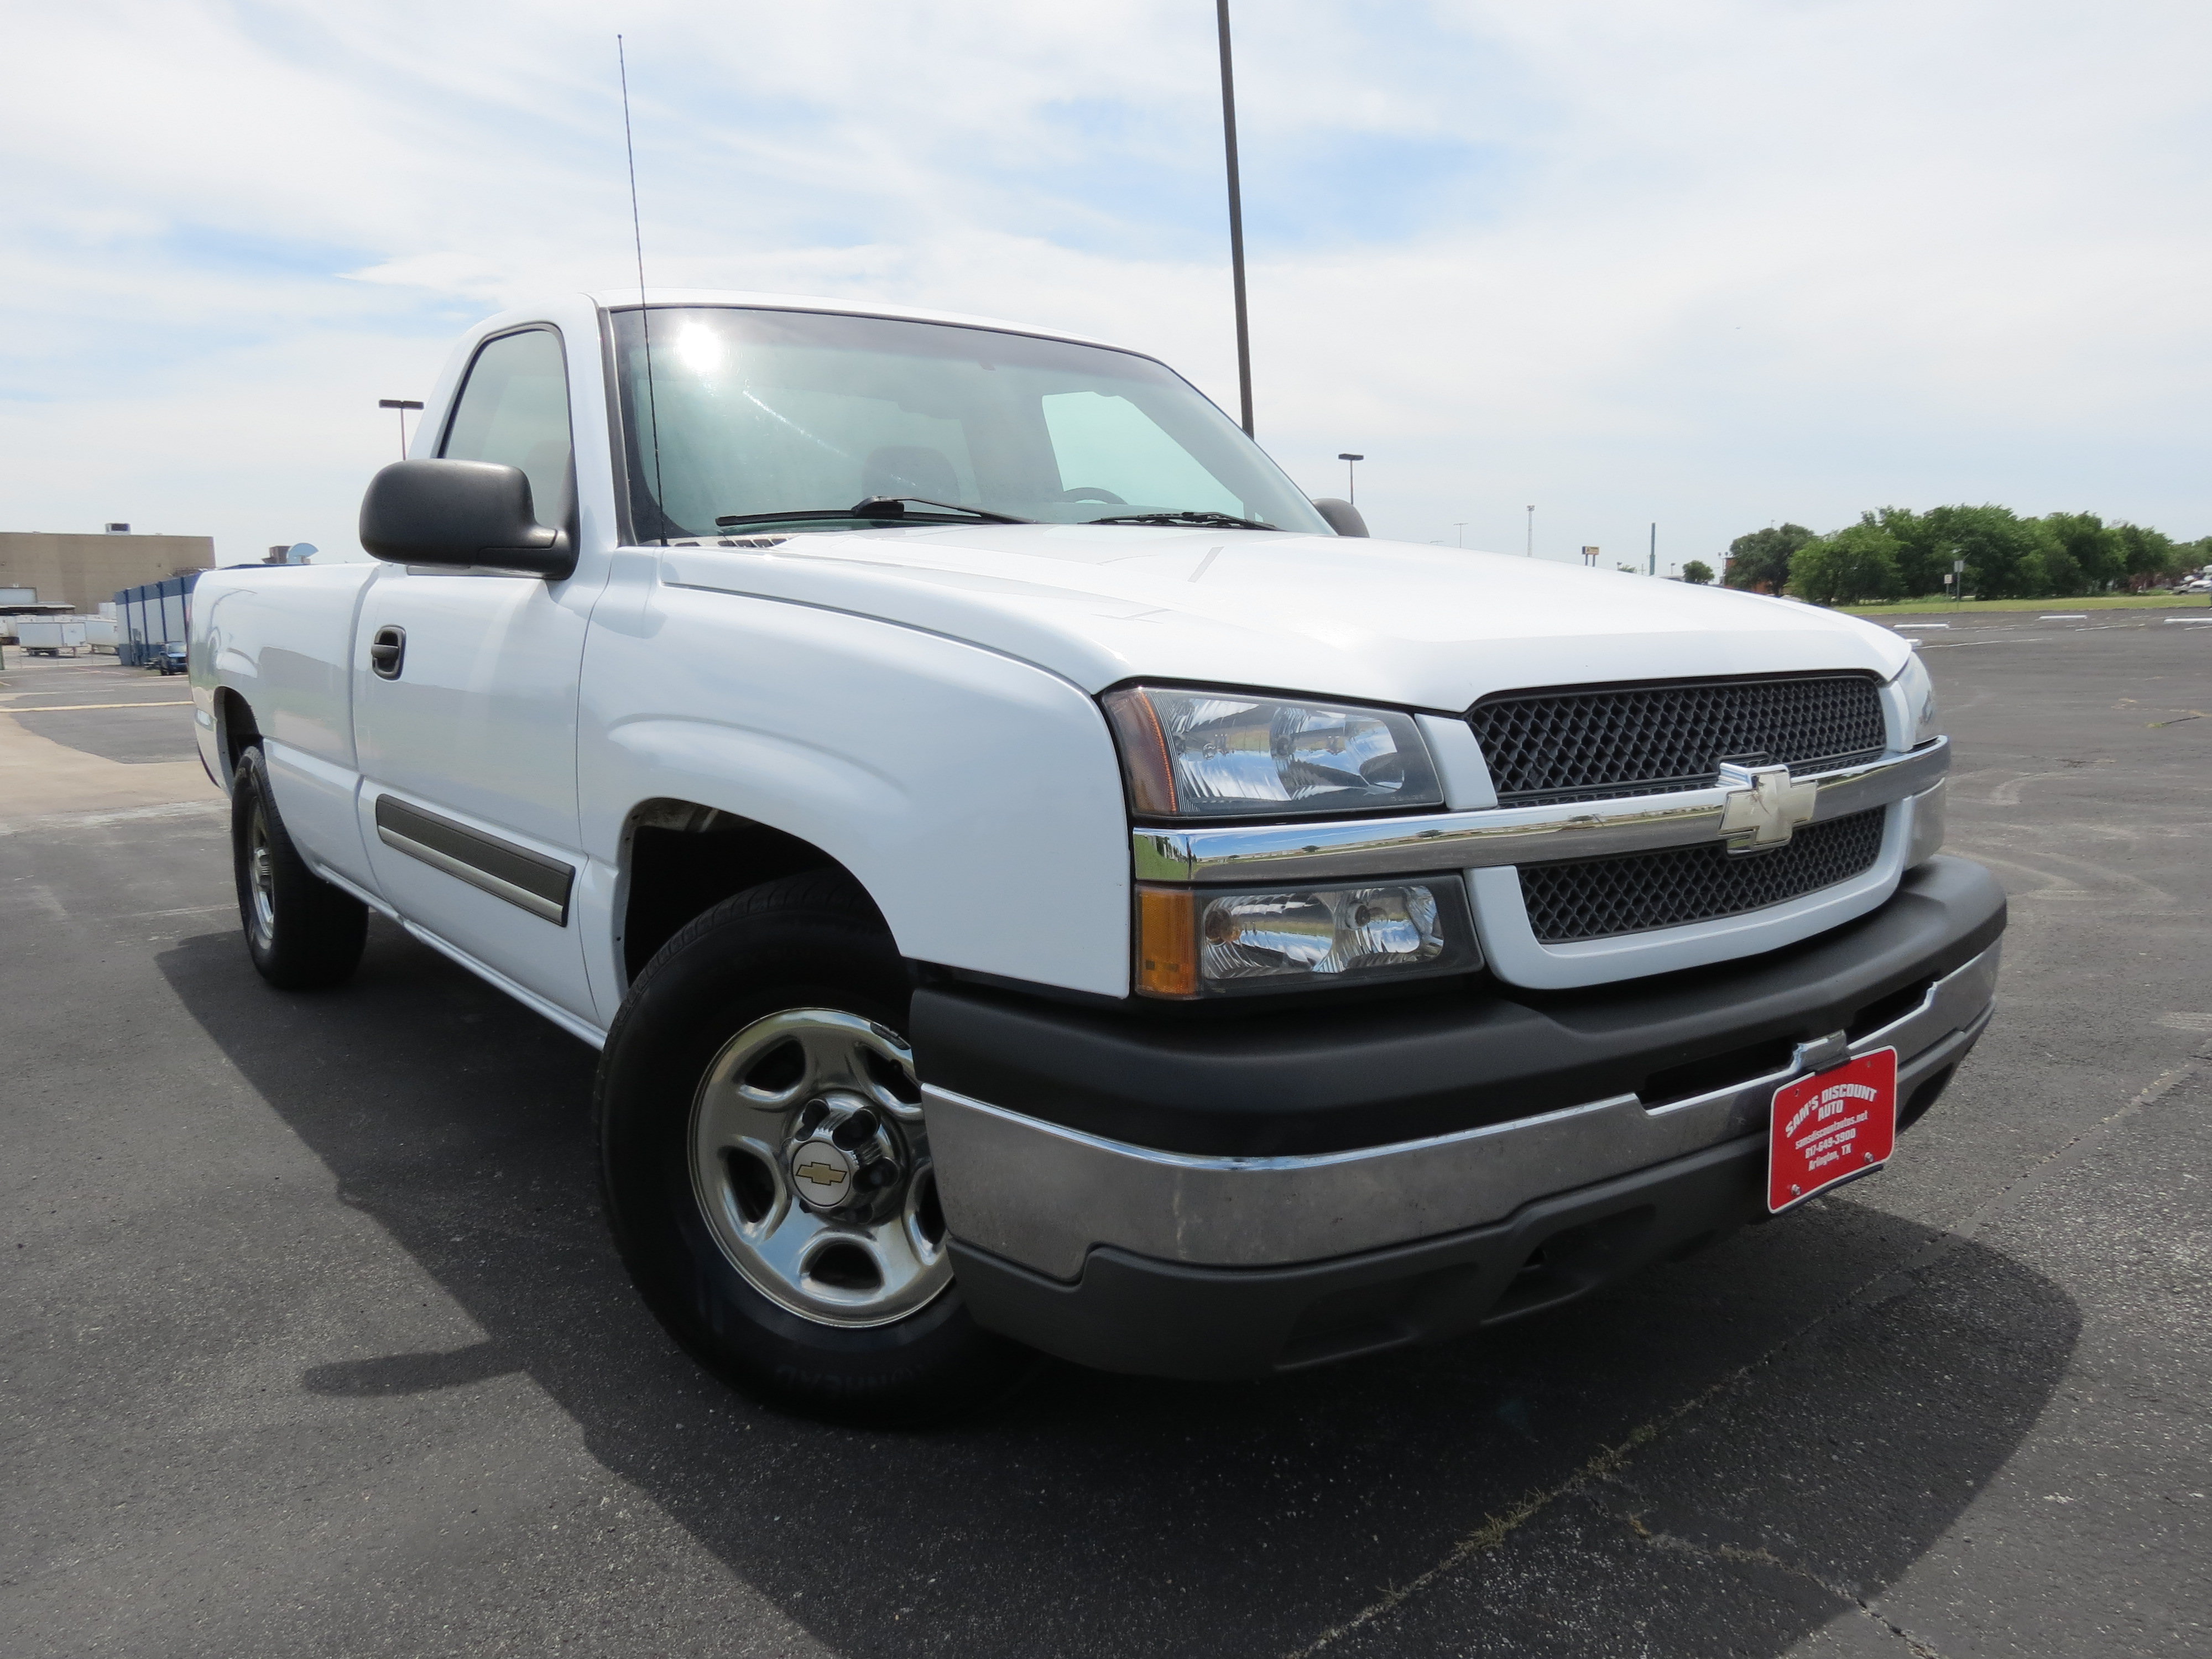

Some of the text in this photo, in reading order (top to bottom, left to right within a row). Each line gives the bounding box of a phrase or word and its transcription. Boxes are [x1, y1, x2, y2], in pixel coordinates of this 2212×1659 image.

[1785, 1083, 1877, 1138] SAM'S DISCOUNT
[1818, 1099, 1844, 1121] AUTO
[1805, 1128, 1856, 1159] 817-649-3900
[1808, 1143, 1851, 1171] Arlington, TX
